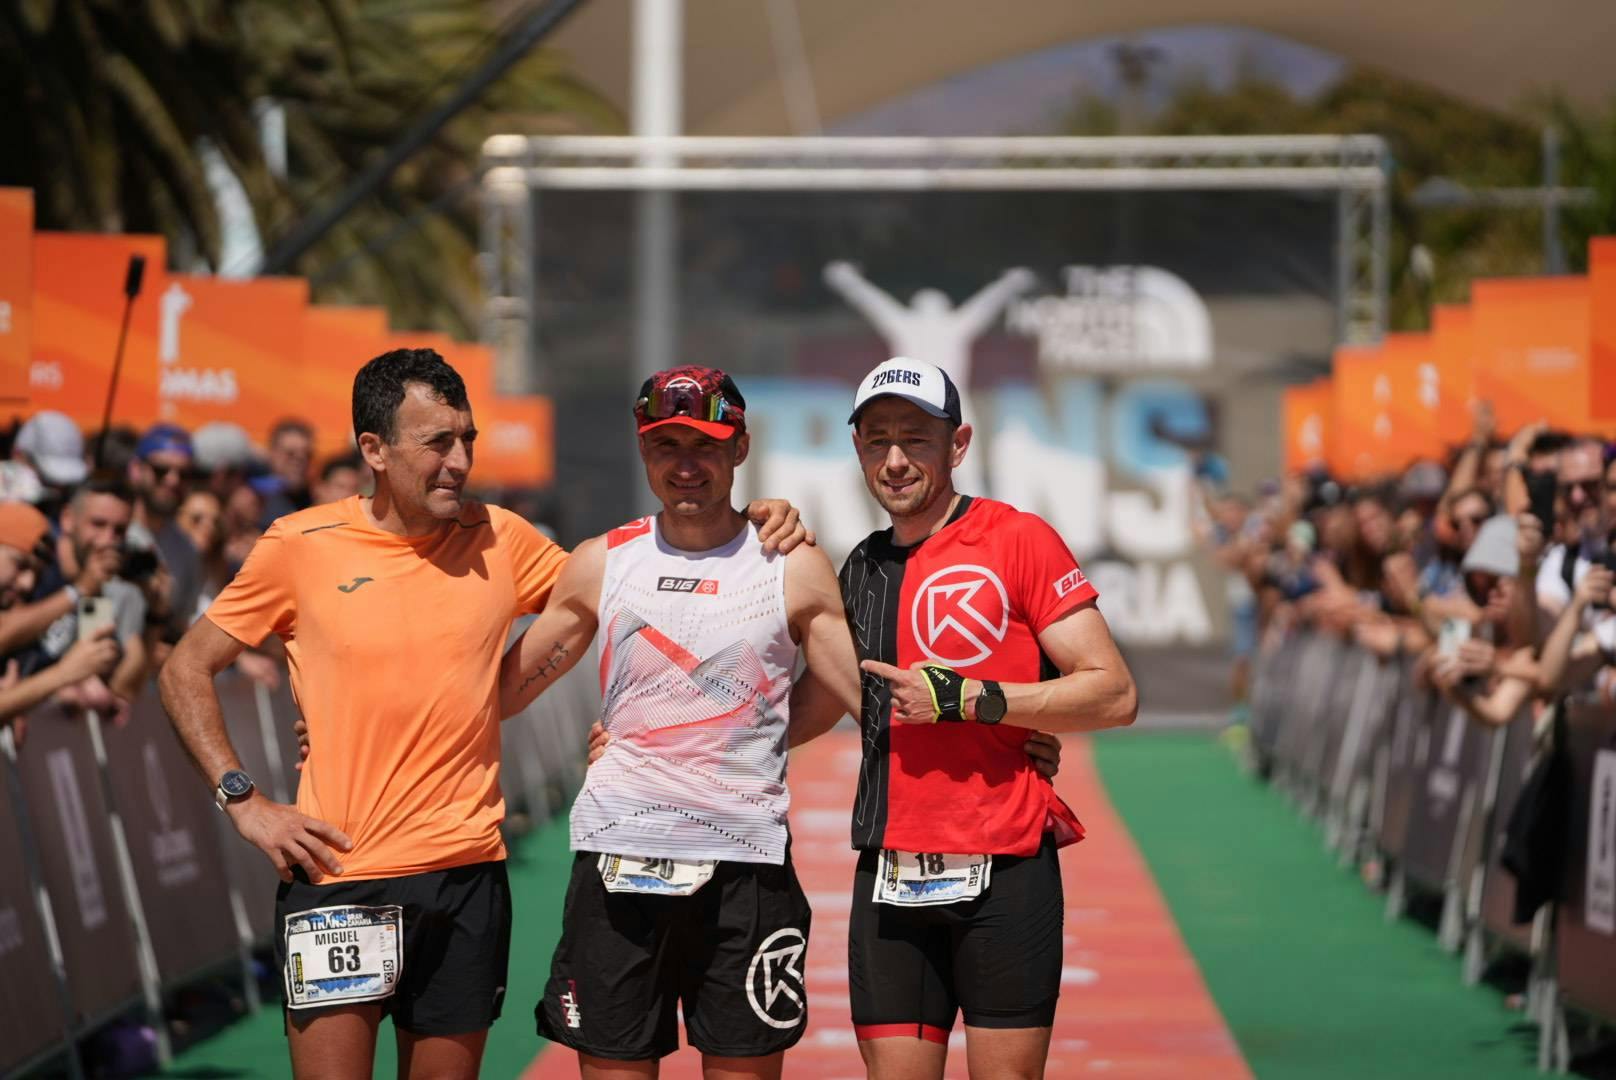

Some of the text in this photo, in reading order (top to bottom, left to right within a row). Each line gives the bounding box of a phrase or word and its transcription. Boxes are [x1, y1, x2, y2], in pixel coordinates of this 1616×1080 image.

[872, 369, 920, 389] 226ERS
[660, 579, 696, 590] BIG
[915, 853, 945, 877] 18
[315, 931, 359, 946] MIGUEL
[328, 945, 361, 973] 63
